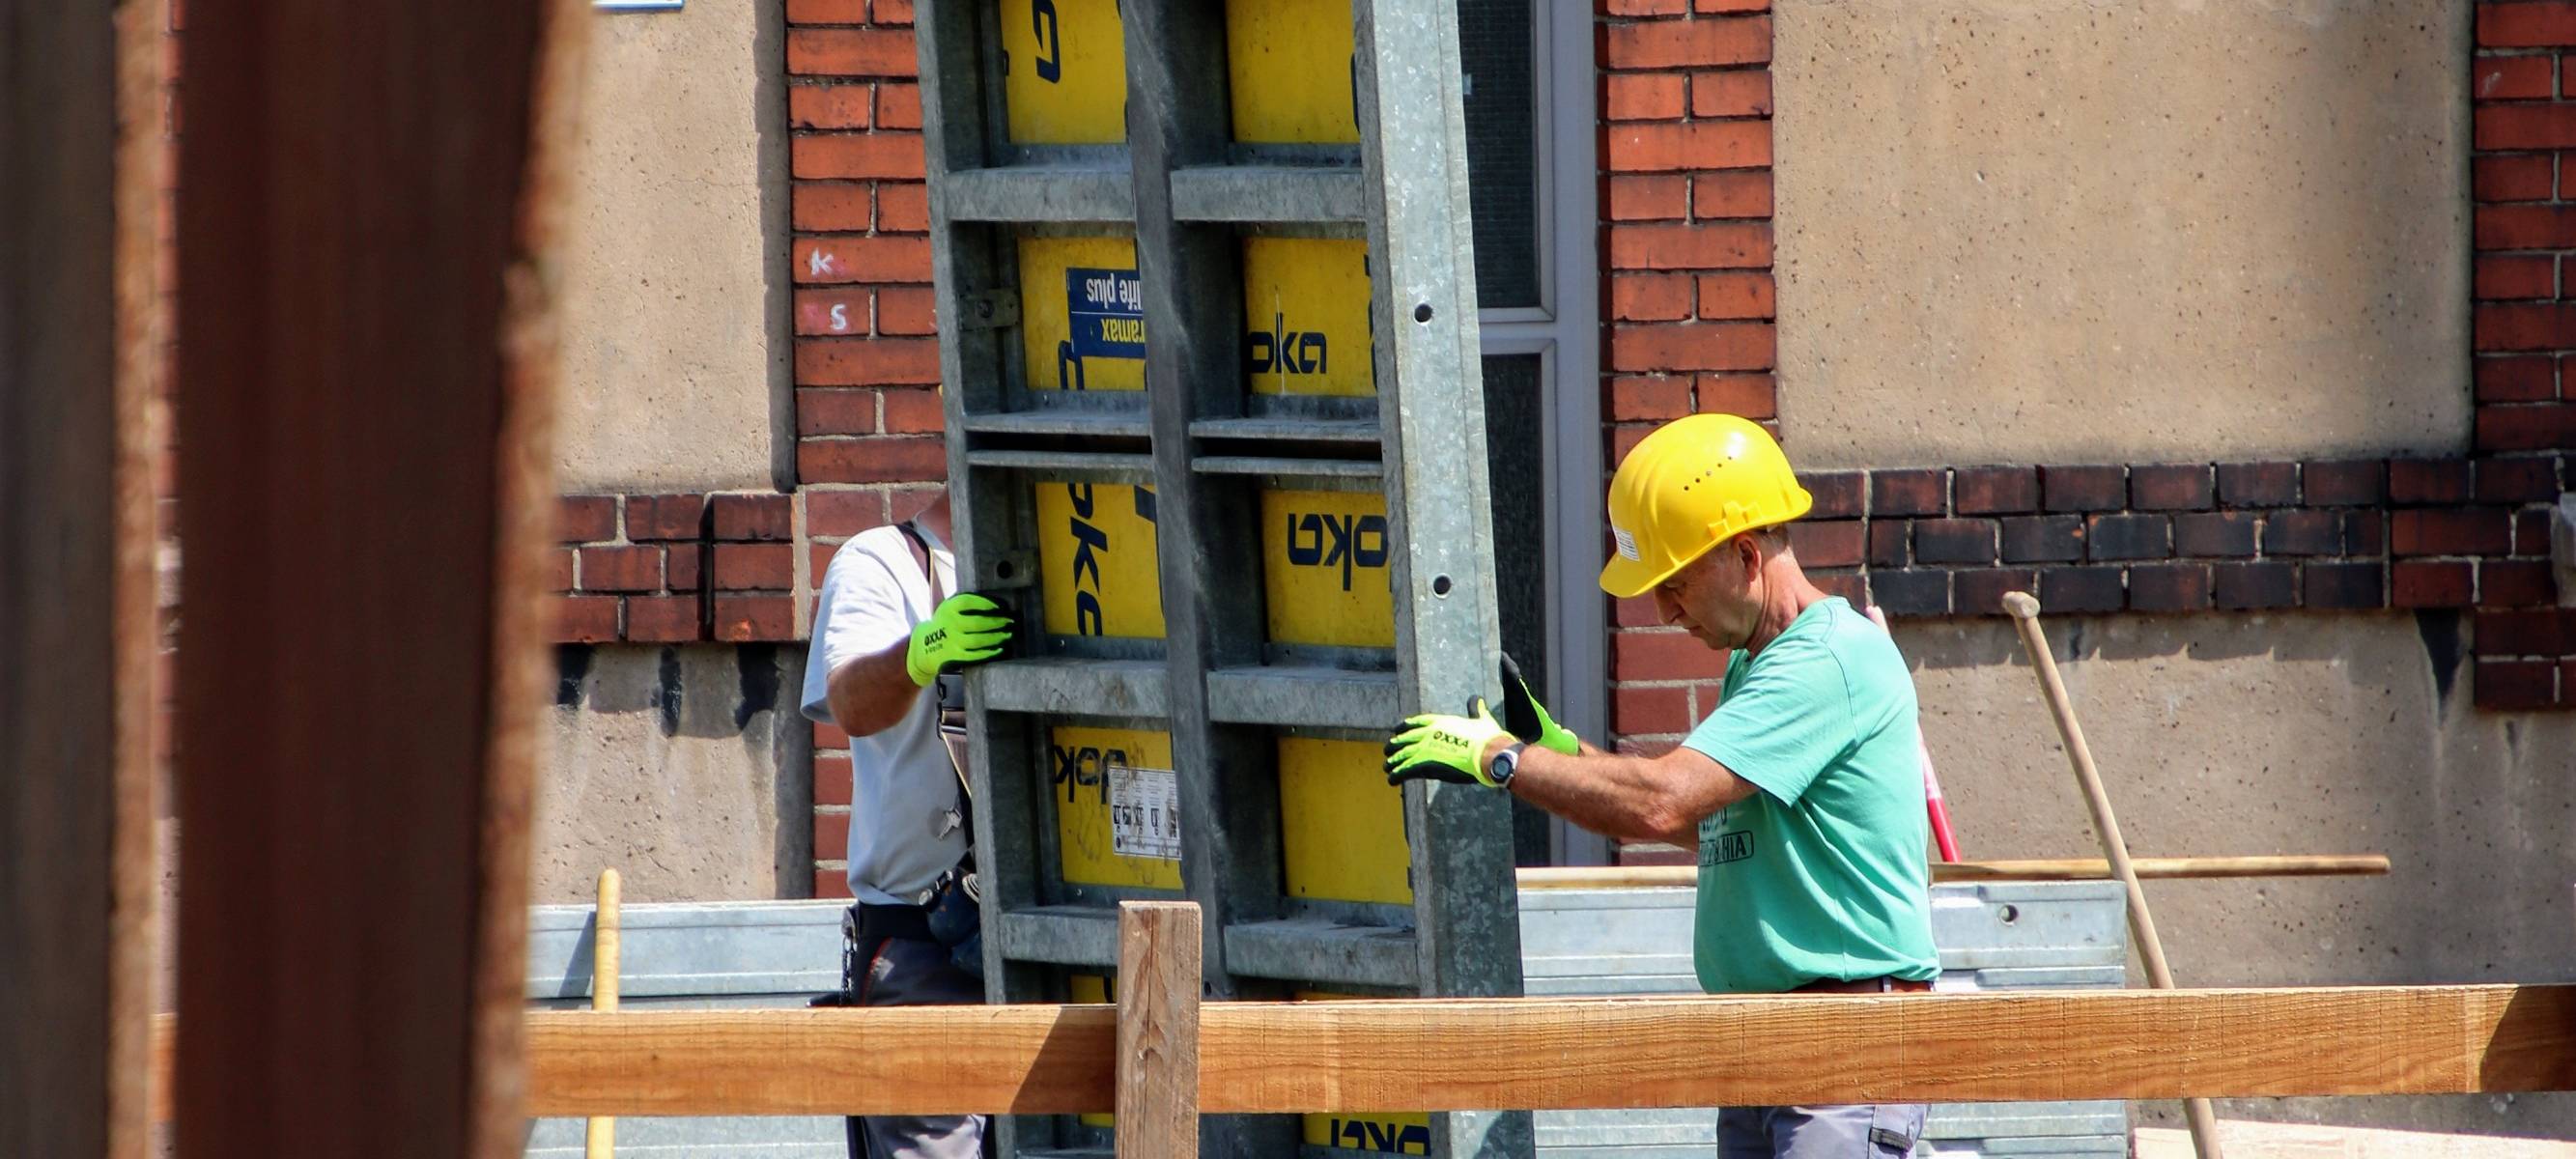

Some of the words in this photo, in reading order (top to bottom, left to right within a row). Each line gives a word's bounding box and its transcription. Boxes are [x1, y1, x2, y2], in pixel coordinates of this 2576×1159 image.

[1086, 272, 1117, 310] plus
[1118, 278, 1144, 311] life
[1101, 318, 1146, 344] ramax
[1248, 312, 1327, 374] oka
[1288, 513, 1389, 591] oka
[924, 628, 947, 647] OXXA
[1432, 730, 1469, 749] OXXA
[1052, 746, 1128, 805] dok
